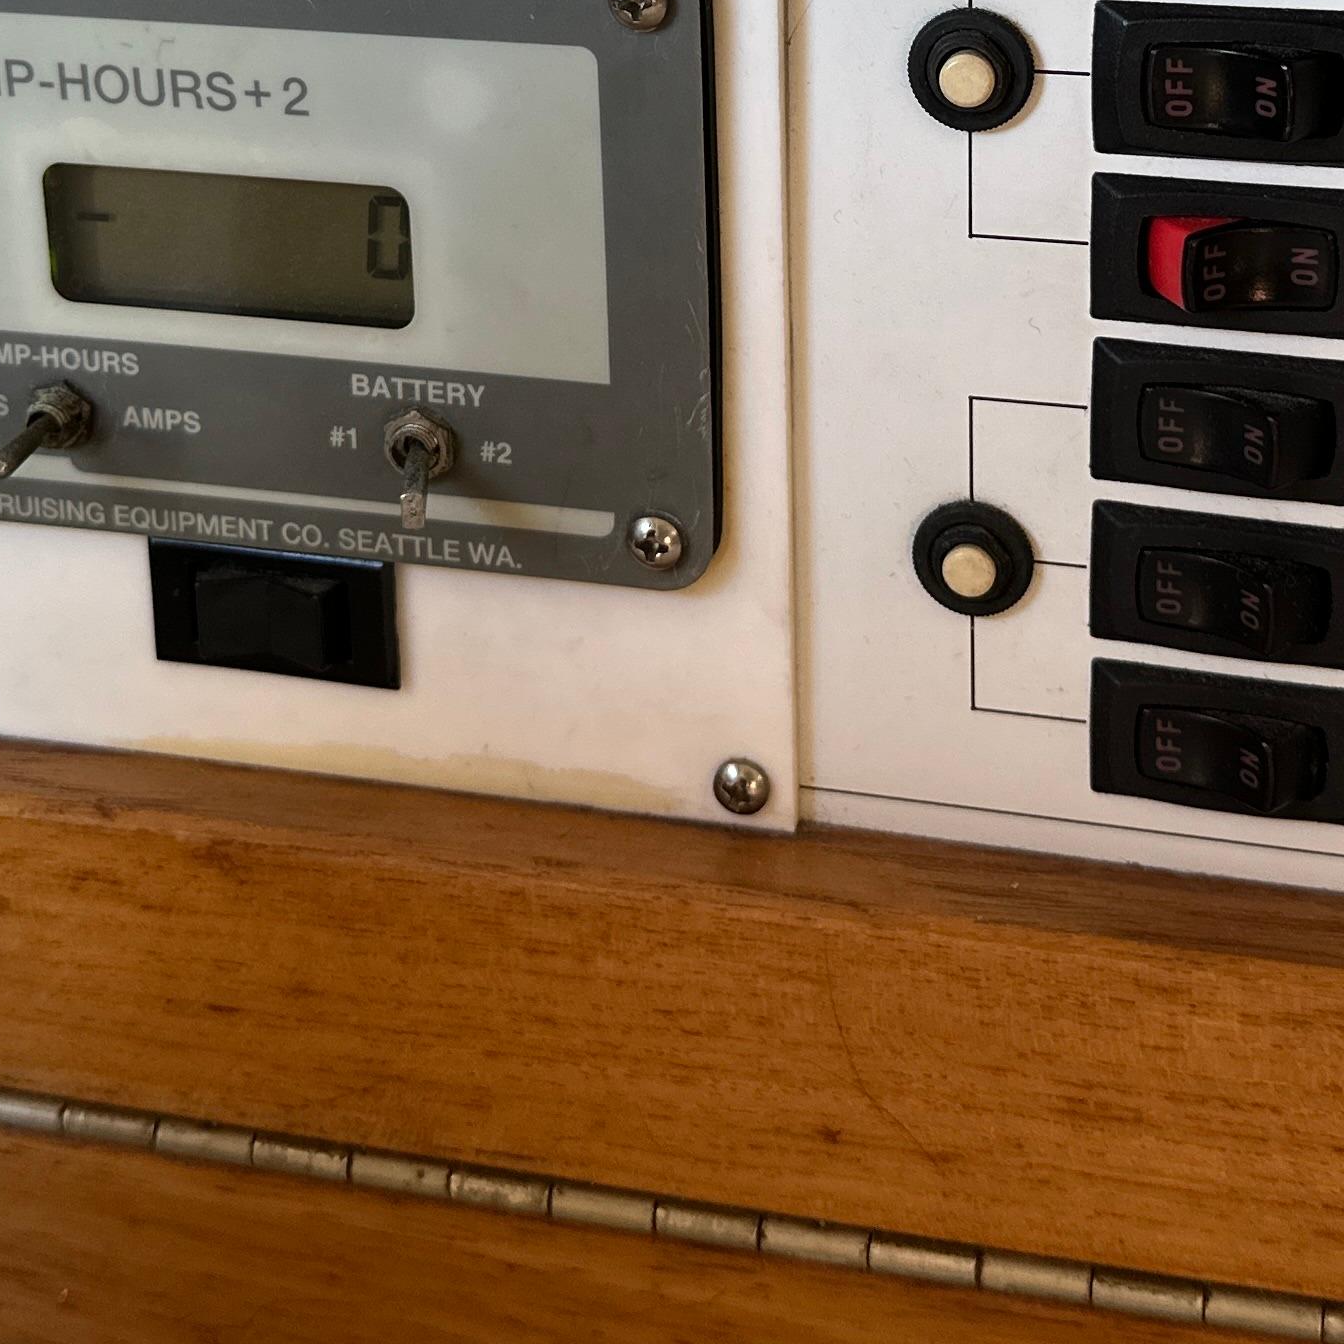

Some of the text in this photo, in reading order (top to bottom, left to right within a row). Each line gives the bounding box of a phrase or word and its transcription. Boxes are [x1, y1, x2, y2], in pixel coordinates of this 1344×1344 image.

[351, 372, 486, 408] BATTERY
[122, 405, 202, 436] AMPS
[329, 425, 513, 466] #1 #2
[113, 502, 274, 544] EQUIPMENT
[281, 517, 333, 547] CO.
[339, 527, 461, 564] SEATTLE
[467, 541, 522, 568] WA.
